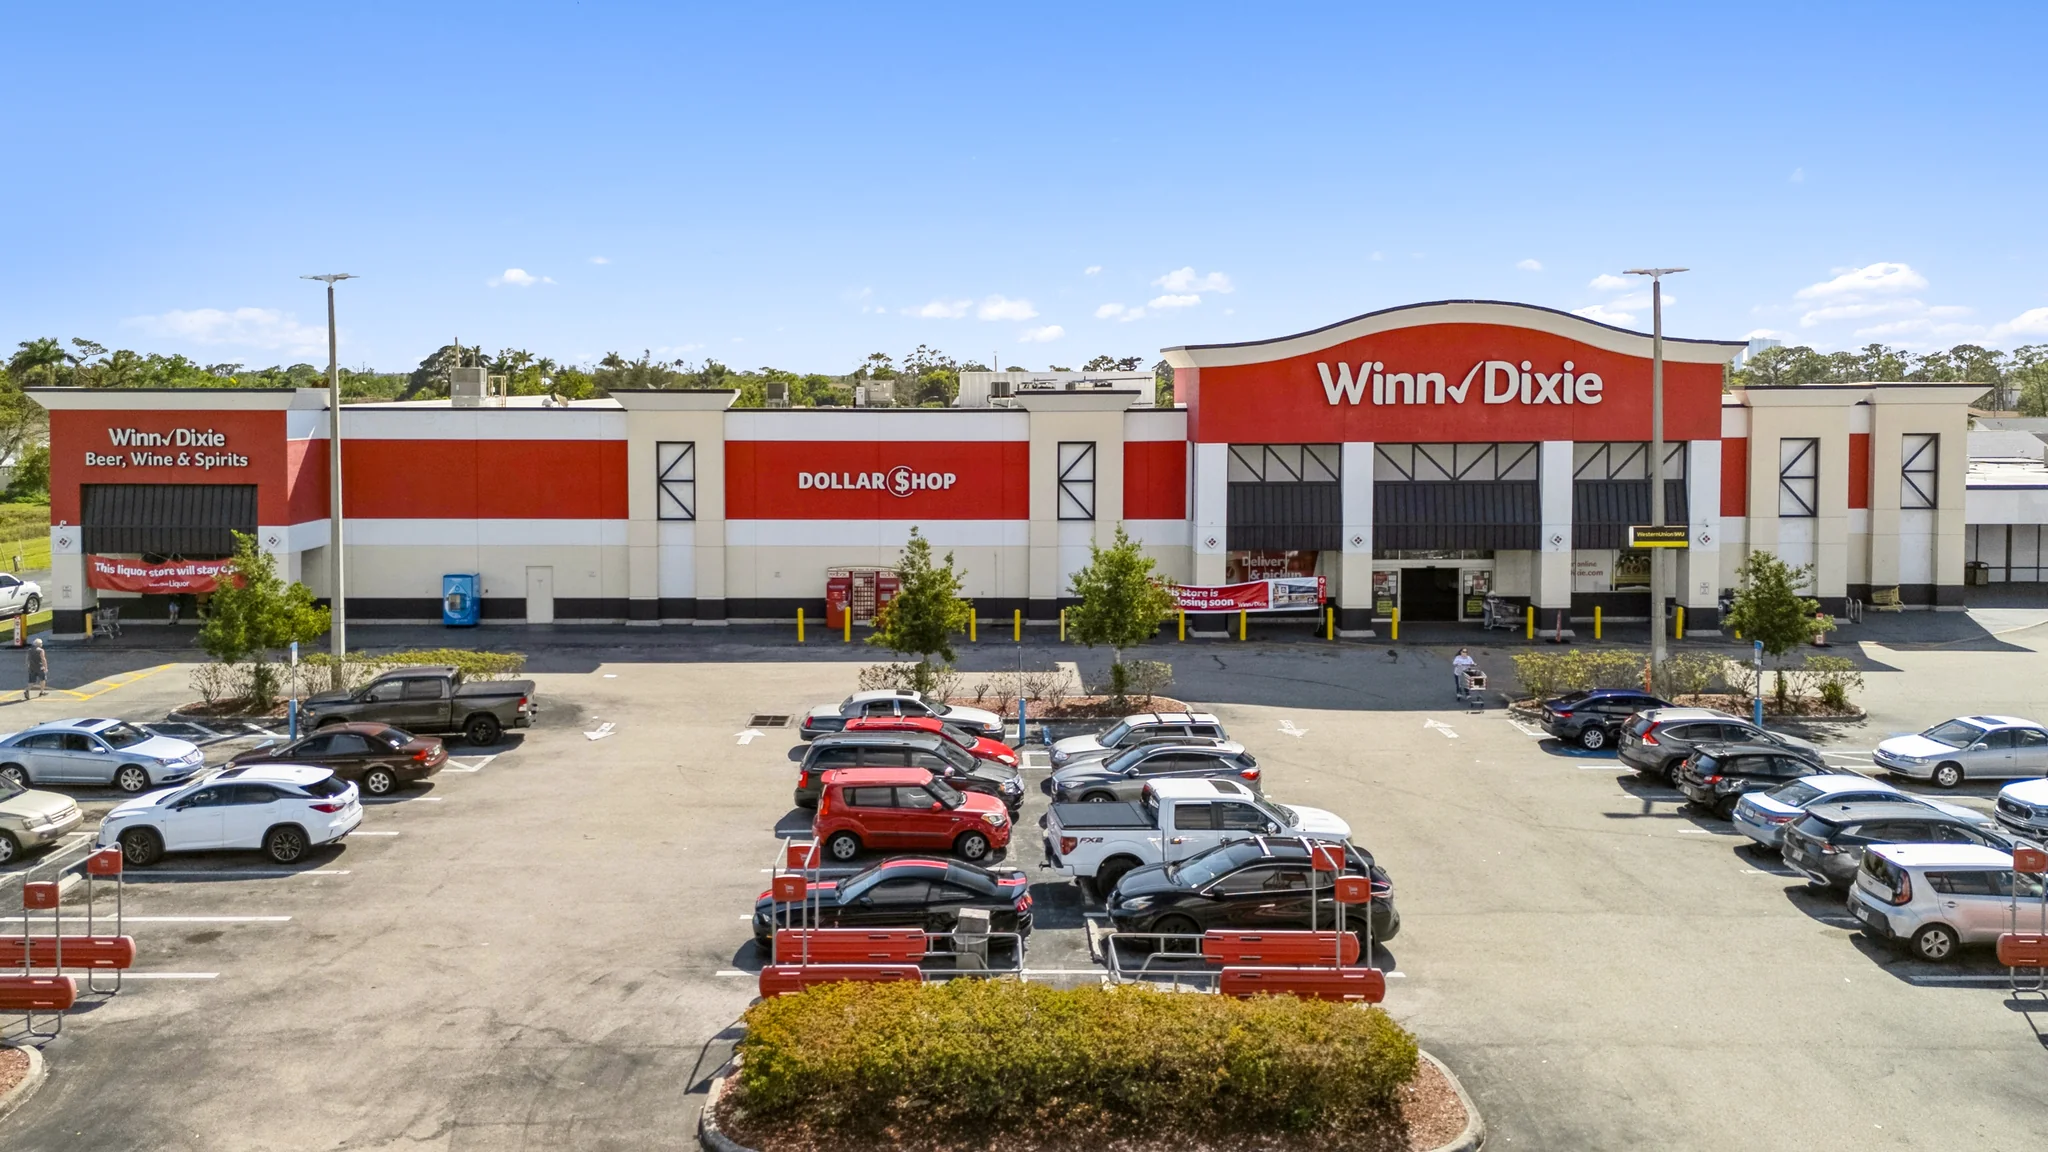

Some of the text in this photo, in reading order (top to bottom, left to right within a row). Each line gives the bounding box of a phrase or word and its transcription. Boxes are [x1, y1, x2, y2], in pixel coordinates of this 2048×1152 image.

[1317, 360, 1603, 405] Winn Dixie
[108, 428, 225, 447] Winn Dixie
[85, 452, 249, 470] Beer, Wine & Spirits
[798, 472, 885, 490] DOLLAR
[94, 561, 115, 574] This
[117, 564, 147, 577] liquor
[149, 566, 174, 577] store
[176, 564, 195, 576] will
[197, 565, 219, 577] stay
[1242, 556, 1290, 569] Delivery
[1250, 569, 1260, 580] &
[169, 580, 190, 589] Liquor
[1181, 589, 1209, 598] store
[1210, 589, 1219, 597] is
[1209, 598, 1234, 607] soon
